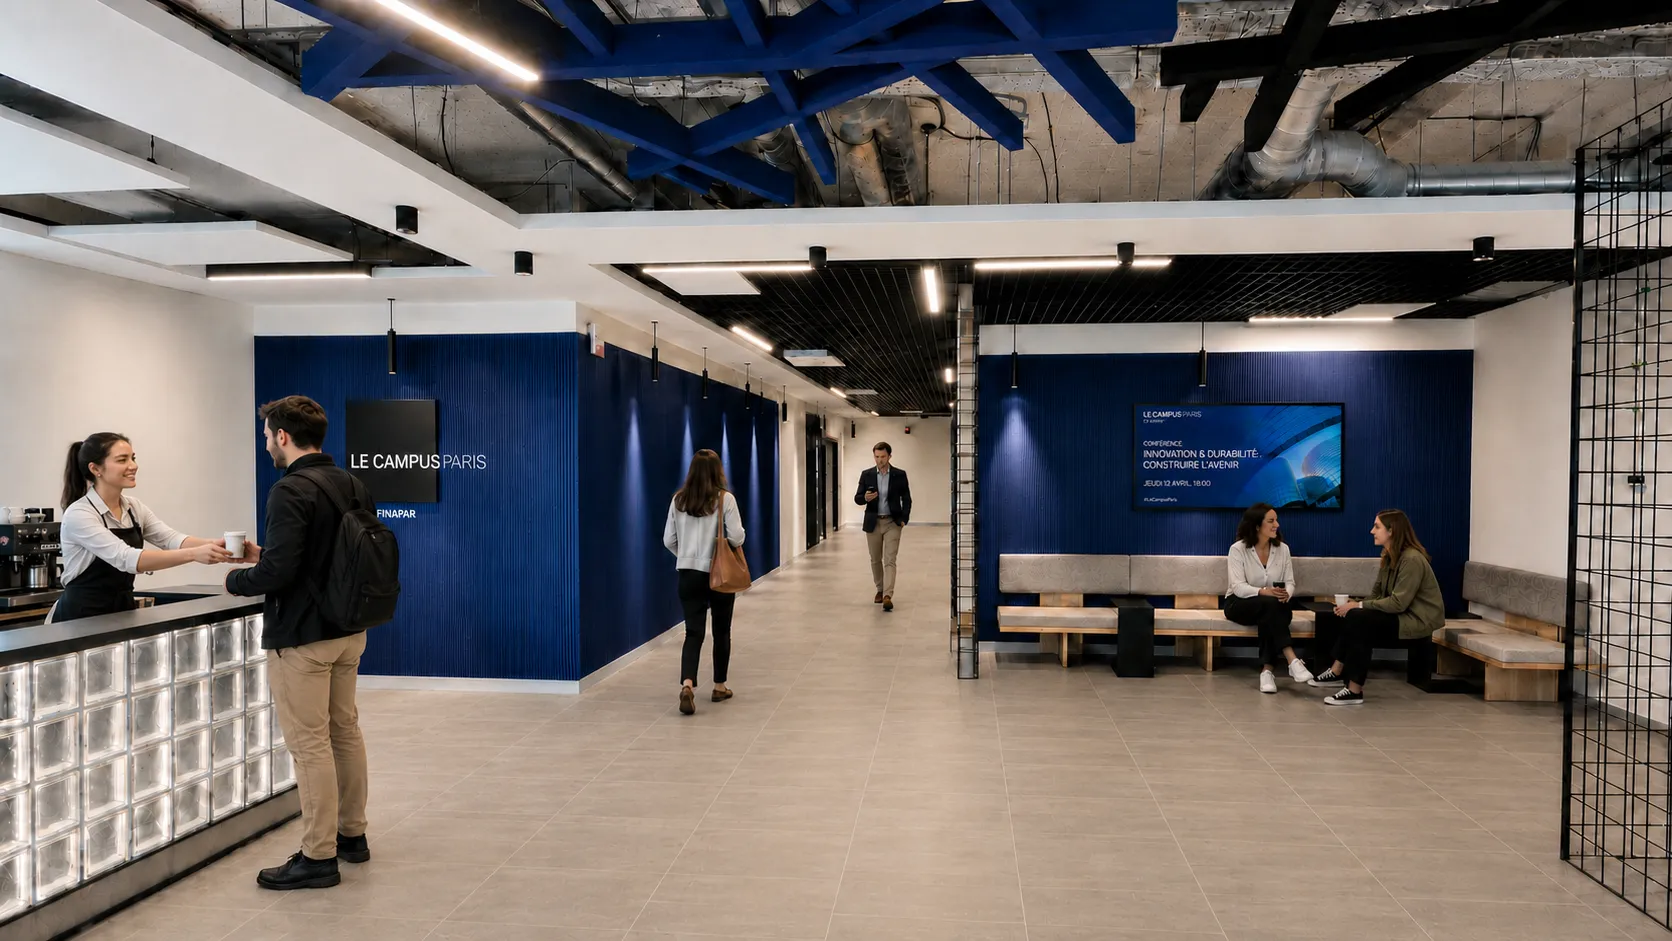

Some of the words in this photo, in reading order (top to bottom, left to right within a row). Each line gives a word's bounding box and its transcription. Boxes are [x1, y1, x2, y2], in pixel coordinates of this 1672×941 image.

[1143, 450, 1197, 458] INNOVATION
[1199, 450, 1206, 458] &
[350, 453, 369, 469] LE
[373, 453, 440, 470] CAMPUS
[443, 454, 487, 470] PARIS
[1143, 461, 1200, 469] CONSTRUIRE
[1201, 461, 1240, 469] L'AVENIR
[376, 509, 417, 519] FINAPAR
